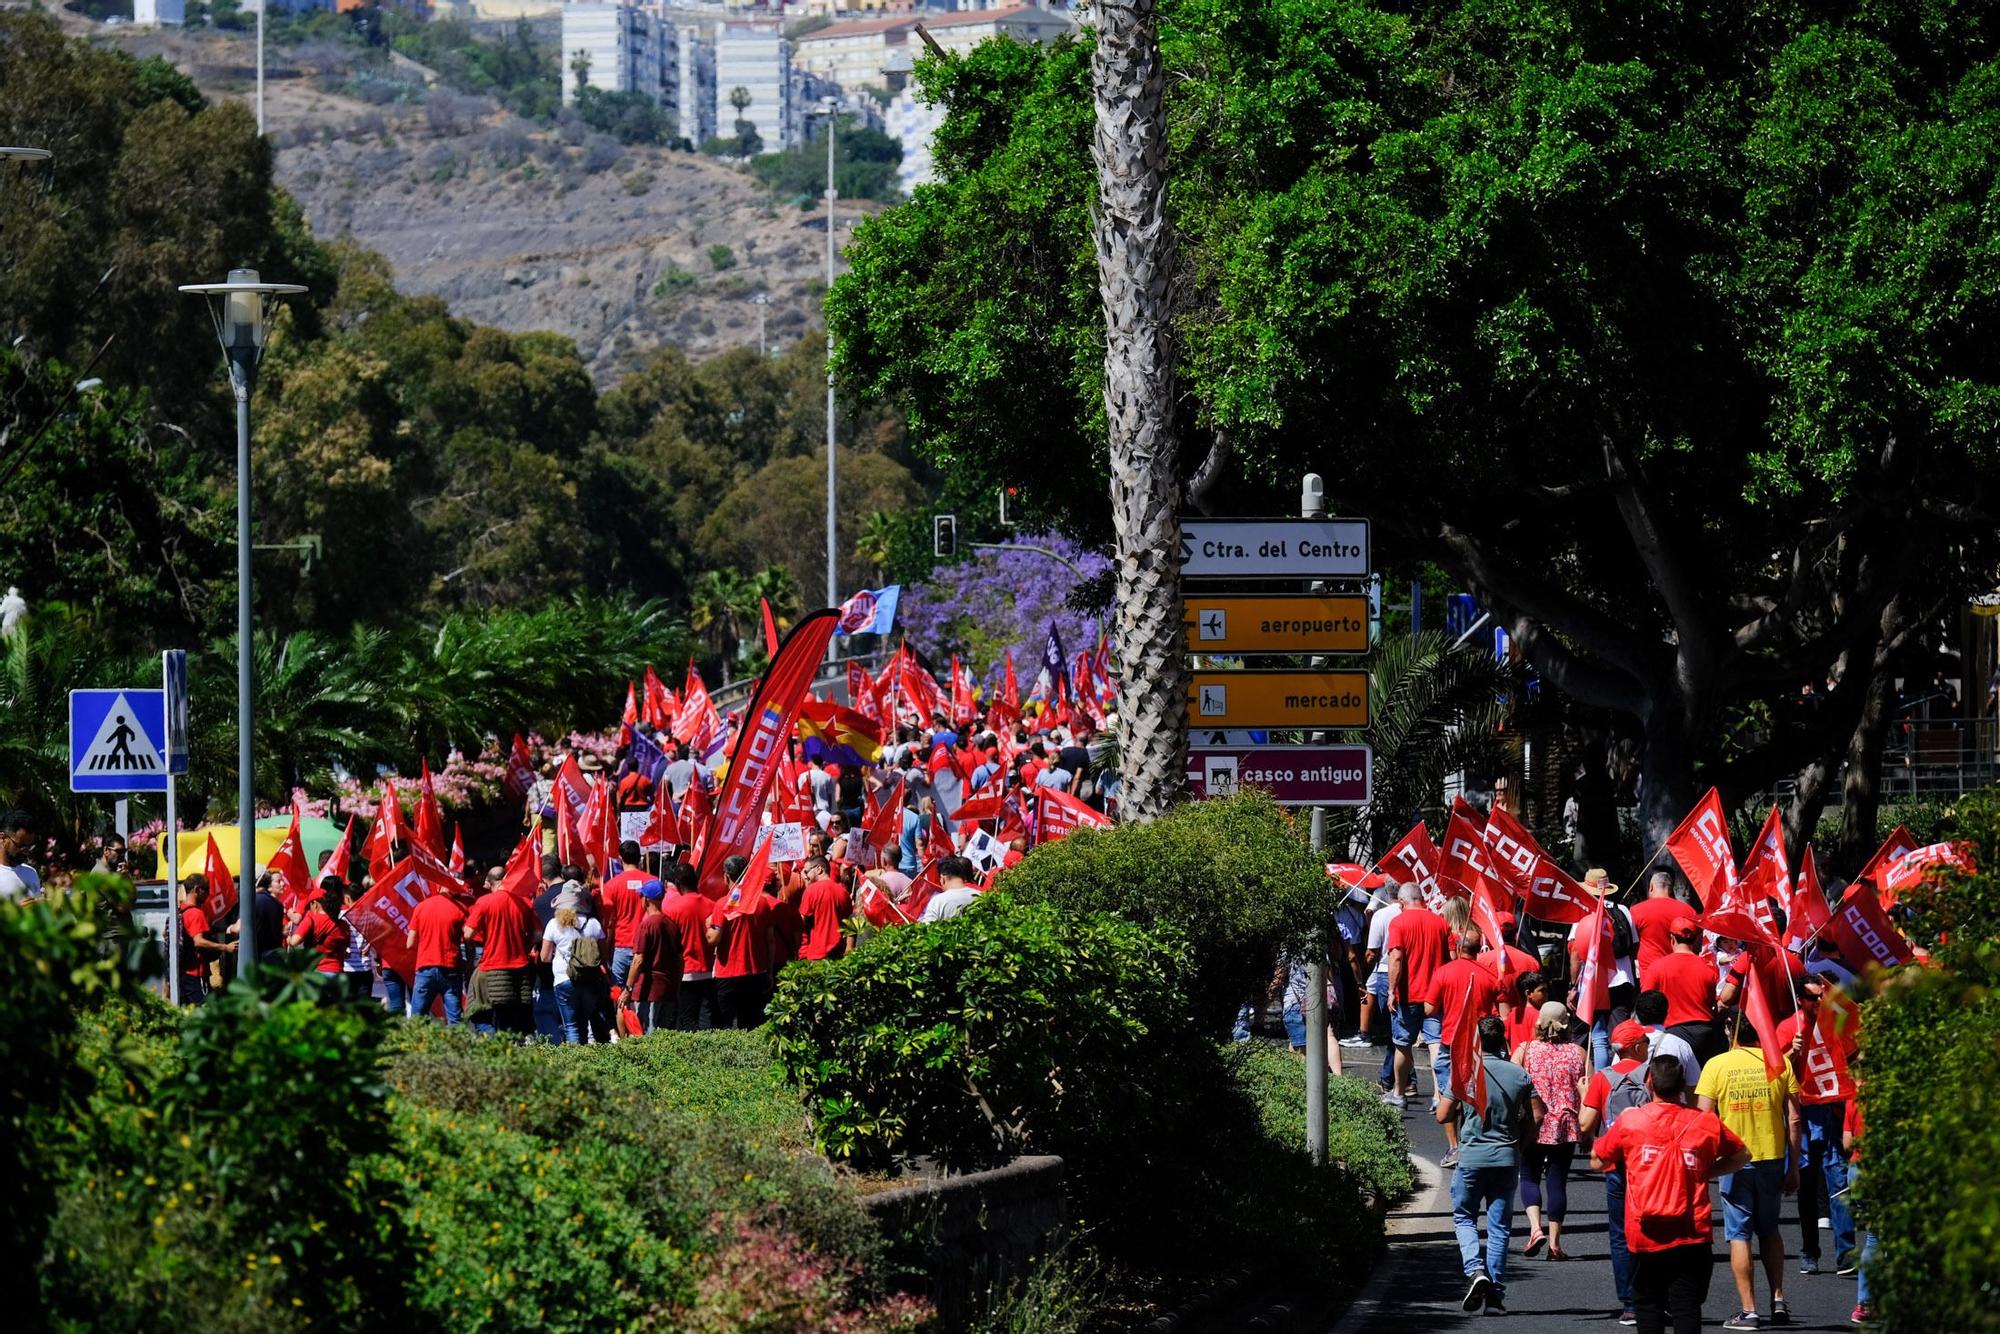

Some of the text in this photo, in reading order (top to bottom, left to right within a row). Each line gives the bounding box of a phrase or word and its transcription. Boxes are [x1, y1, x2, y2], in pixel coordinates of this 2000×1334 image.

[1203, 541, 1360, 558] Ctra. del Centro
[1261, 617, 1361, 636] aeropuerto
[1285, 692, 1361, 708] mercado
[1244, 767, 1363, 785] casco antiguo
